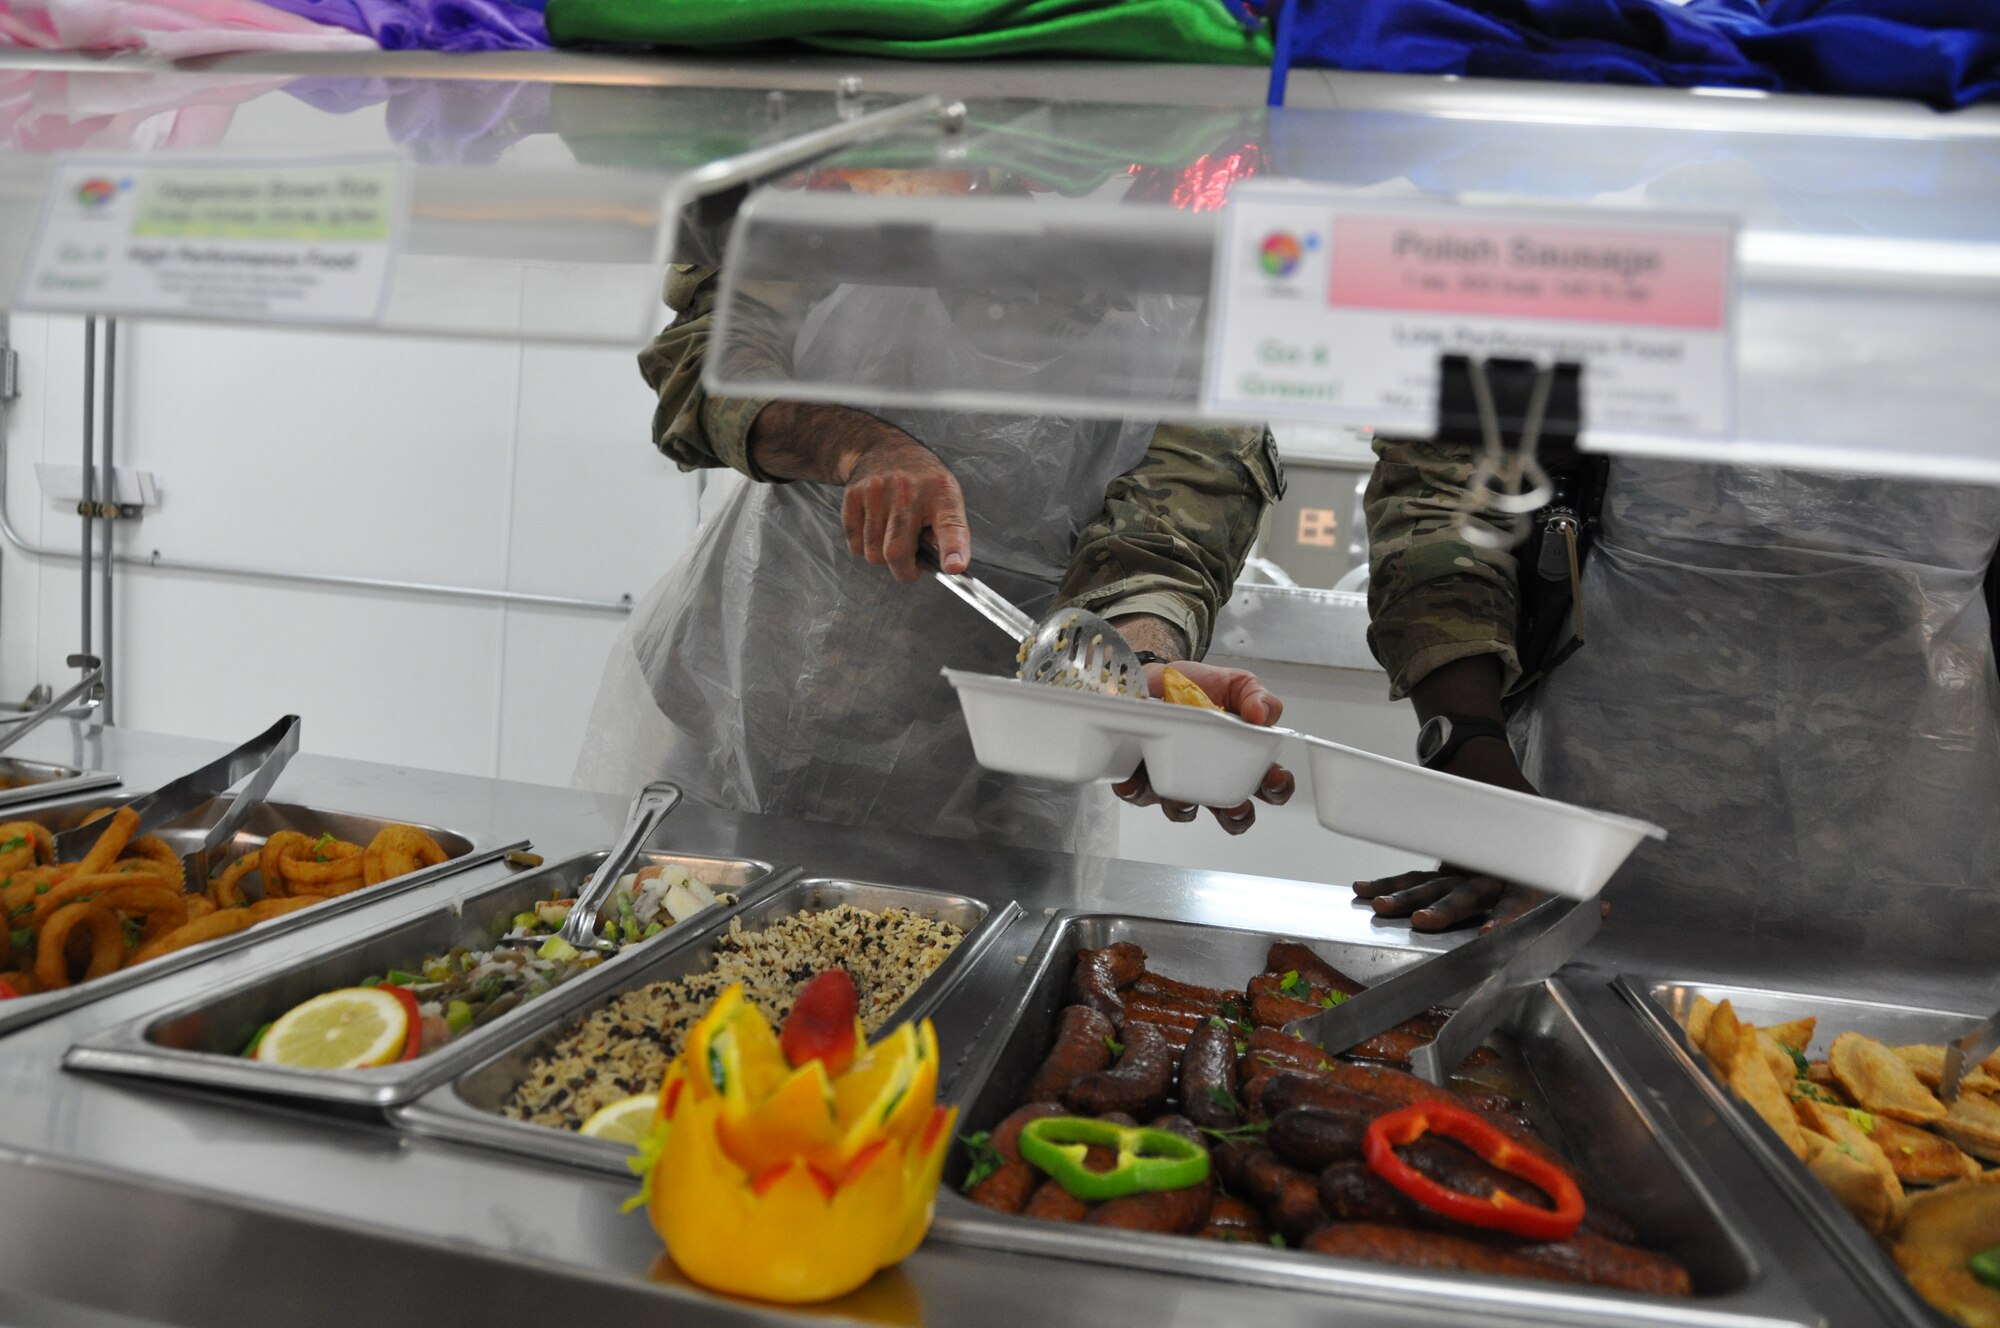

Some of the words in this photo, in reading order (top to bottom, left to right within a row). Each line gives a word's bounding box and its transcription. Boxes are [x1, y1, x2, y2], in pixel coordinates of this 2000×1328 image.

[180, 247, 299, 268] Performance
[306, 249, 359, 270] Food
[1393, 230, 1499, 262] Polish
[1510, 236, 1663, 277] Sausage
[1255, 337, 1301, 367] Go
[1391, 323, 1444, 346] Low
[1454, 326, 1609, 355] Performance
[1619, 335, 1685, 362] Food
[1238, 371, 1342, 400] Green!
